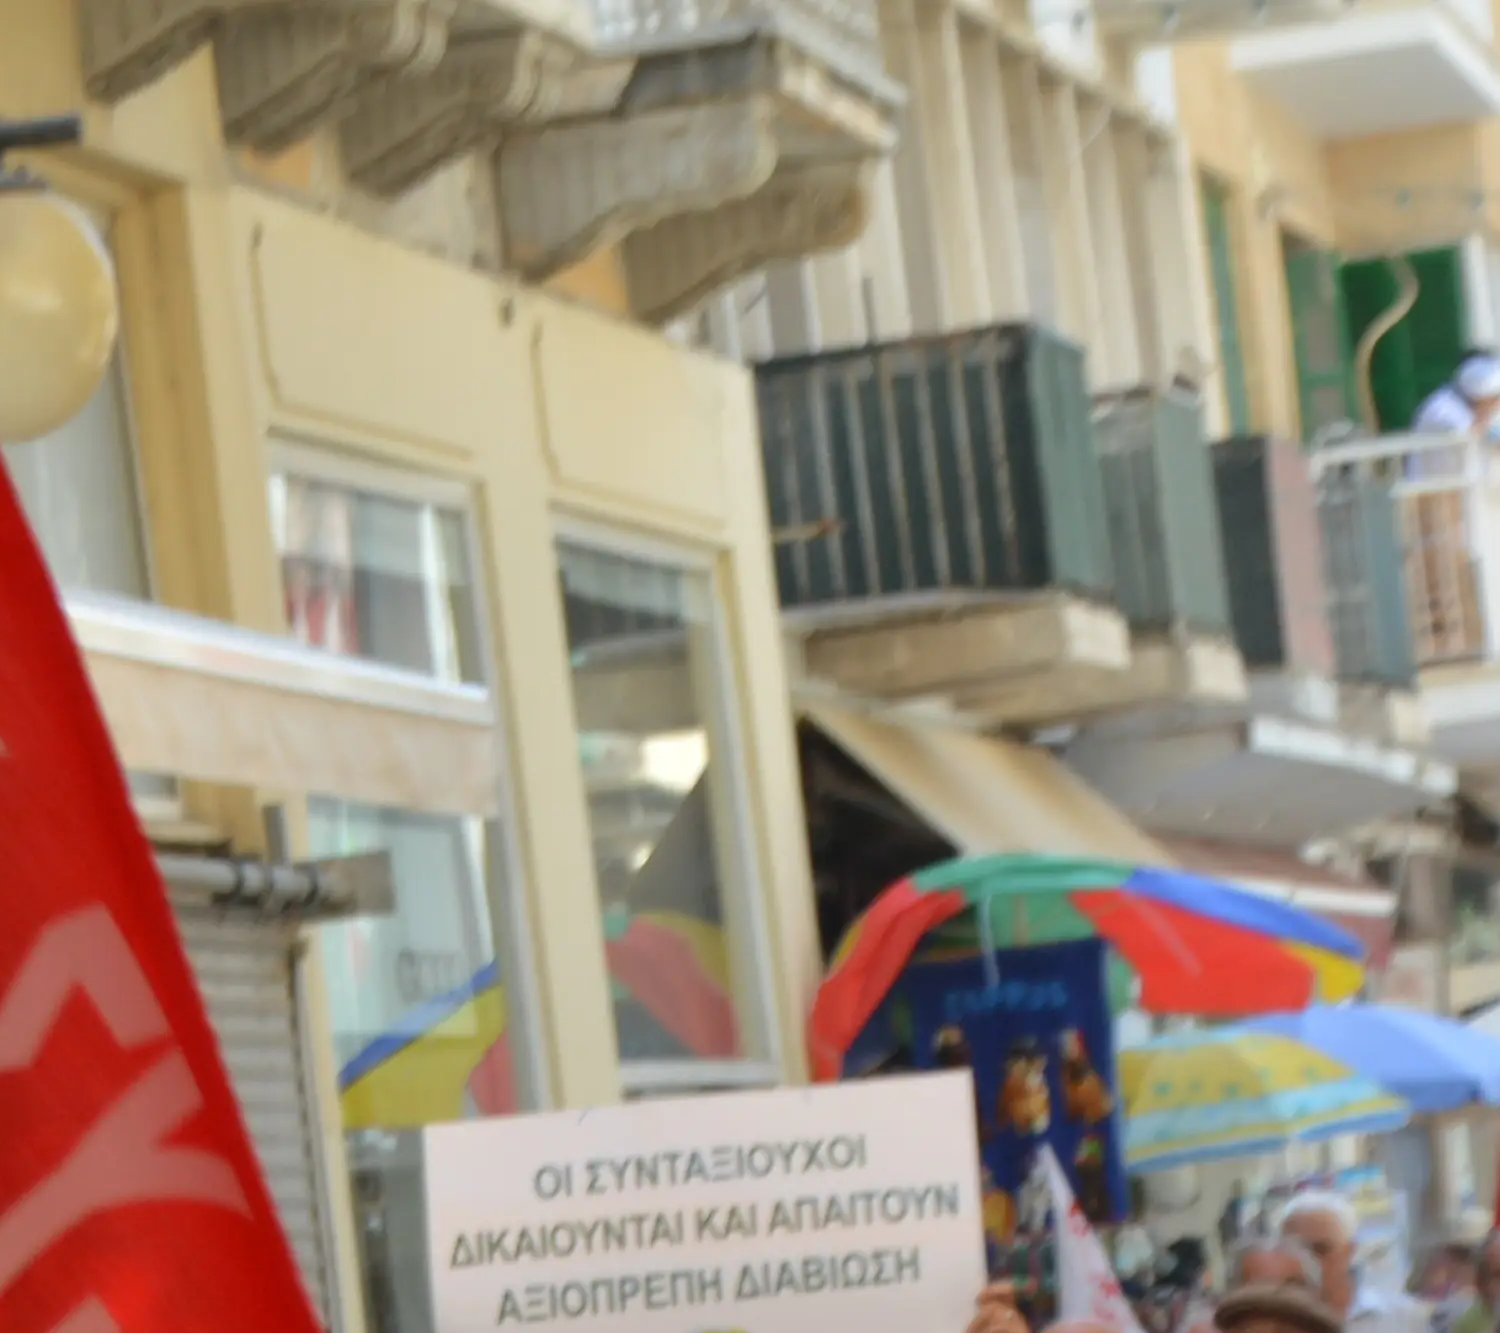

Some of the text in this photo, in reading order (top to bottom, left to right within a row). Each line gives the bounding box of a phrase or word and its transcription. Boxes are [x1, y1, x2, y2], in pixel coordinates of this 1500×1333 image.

[534, 1134, 867, 1201] ΟΙ ΣΥΝΤΑΞΙΟΥΧΟΙ
[449, 1181, 960, 1270] ΔΙΚΑΙΟΥΝΤΑΙ ΚΑΙ ΑΠΑΙΤΟΥΝ
[496, 1246, 921, 1325] ΑΞΙΟΠΡΕΠΗ ΔΙΑΒΙΩΣΗ
